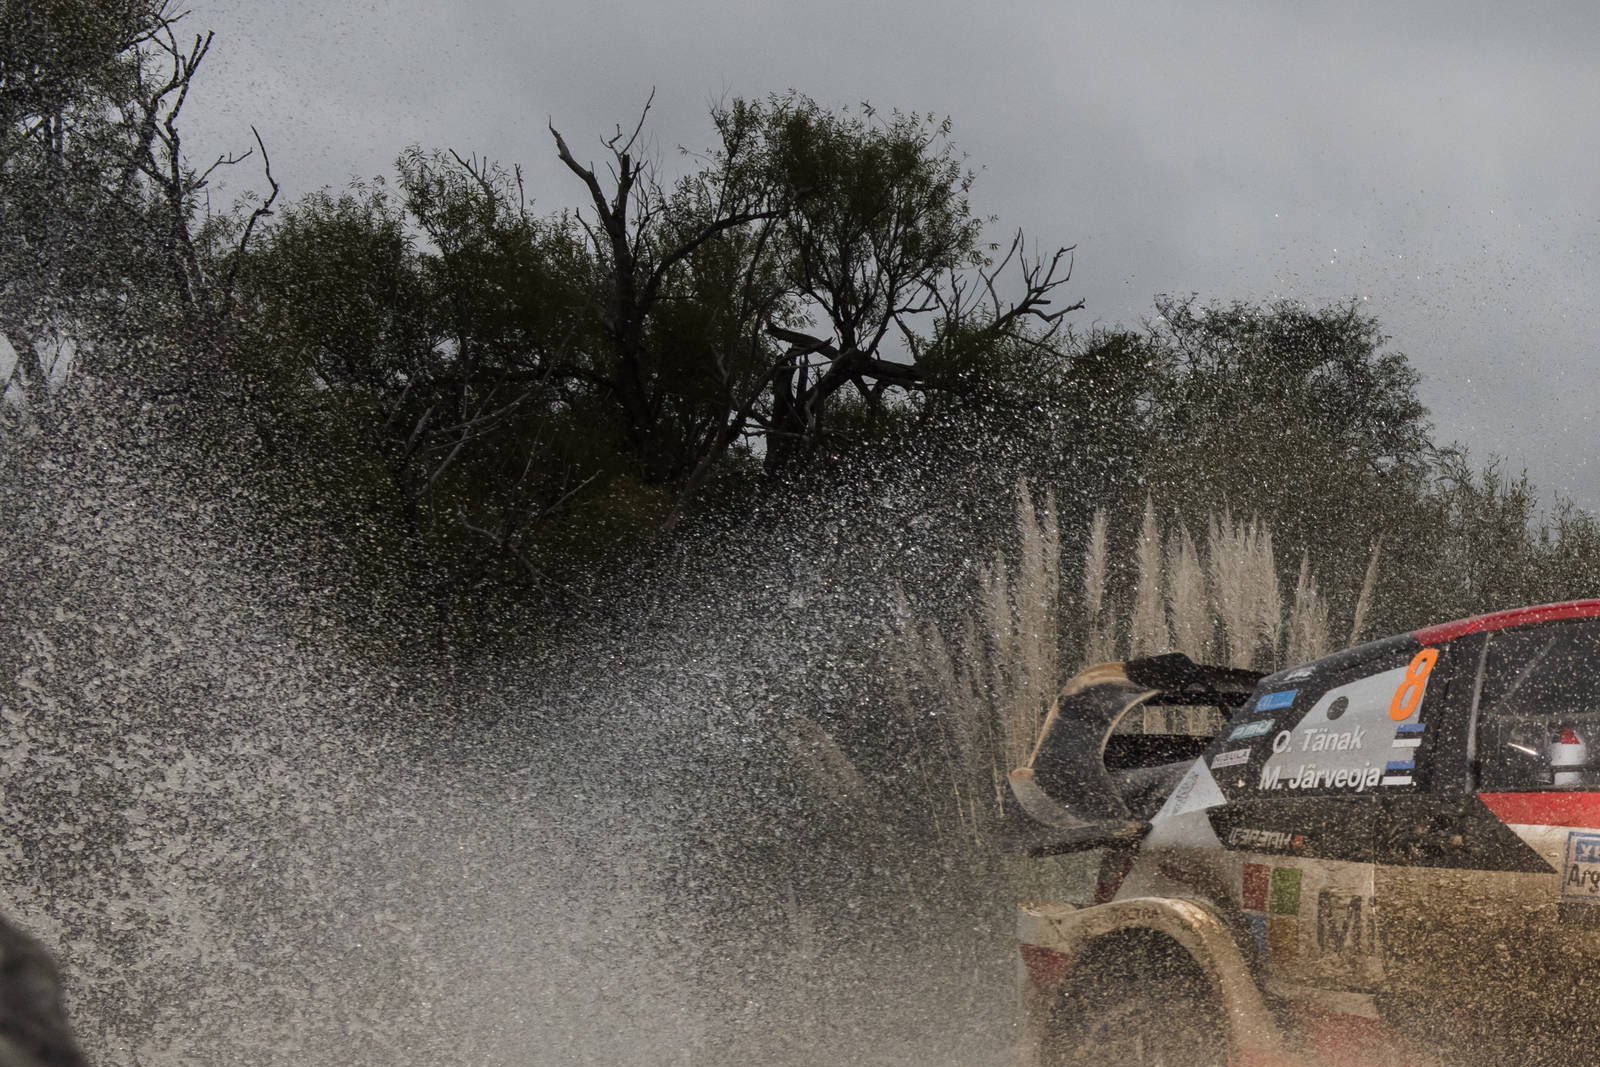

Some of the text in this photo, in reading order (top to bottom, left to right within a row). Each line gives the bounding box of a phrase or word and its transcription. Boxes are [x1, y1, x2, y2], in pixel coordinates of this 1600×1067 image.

[1389, 647, 1439, 721] 8
[1272, 729, 1292, 754] O.
[1301, 724, 1366, 752] Tänak
[1258, 761, 1380, 793] M. Järveoja
